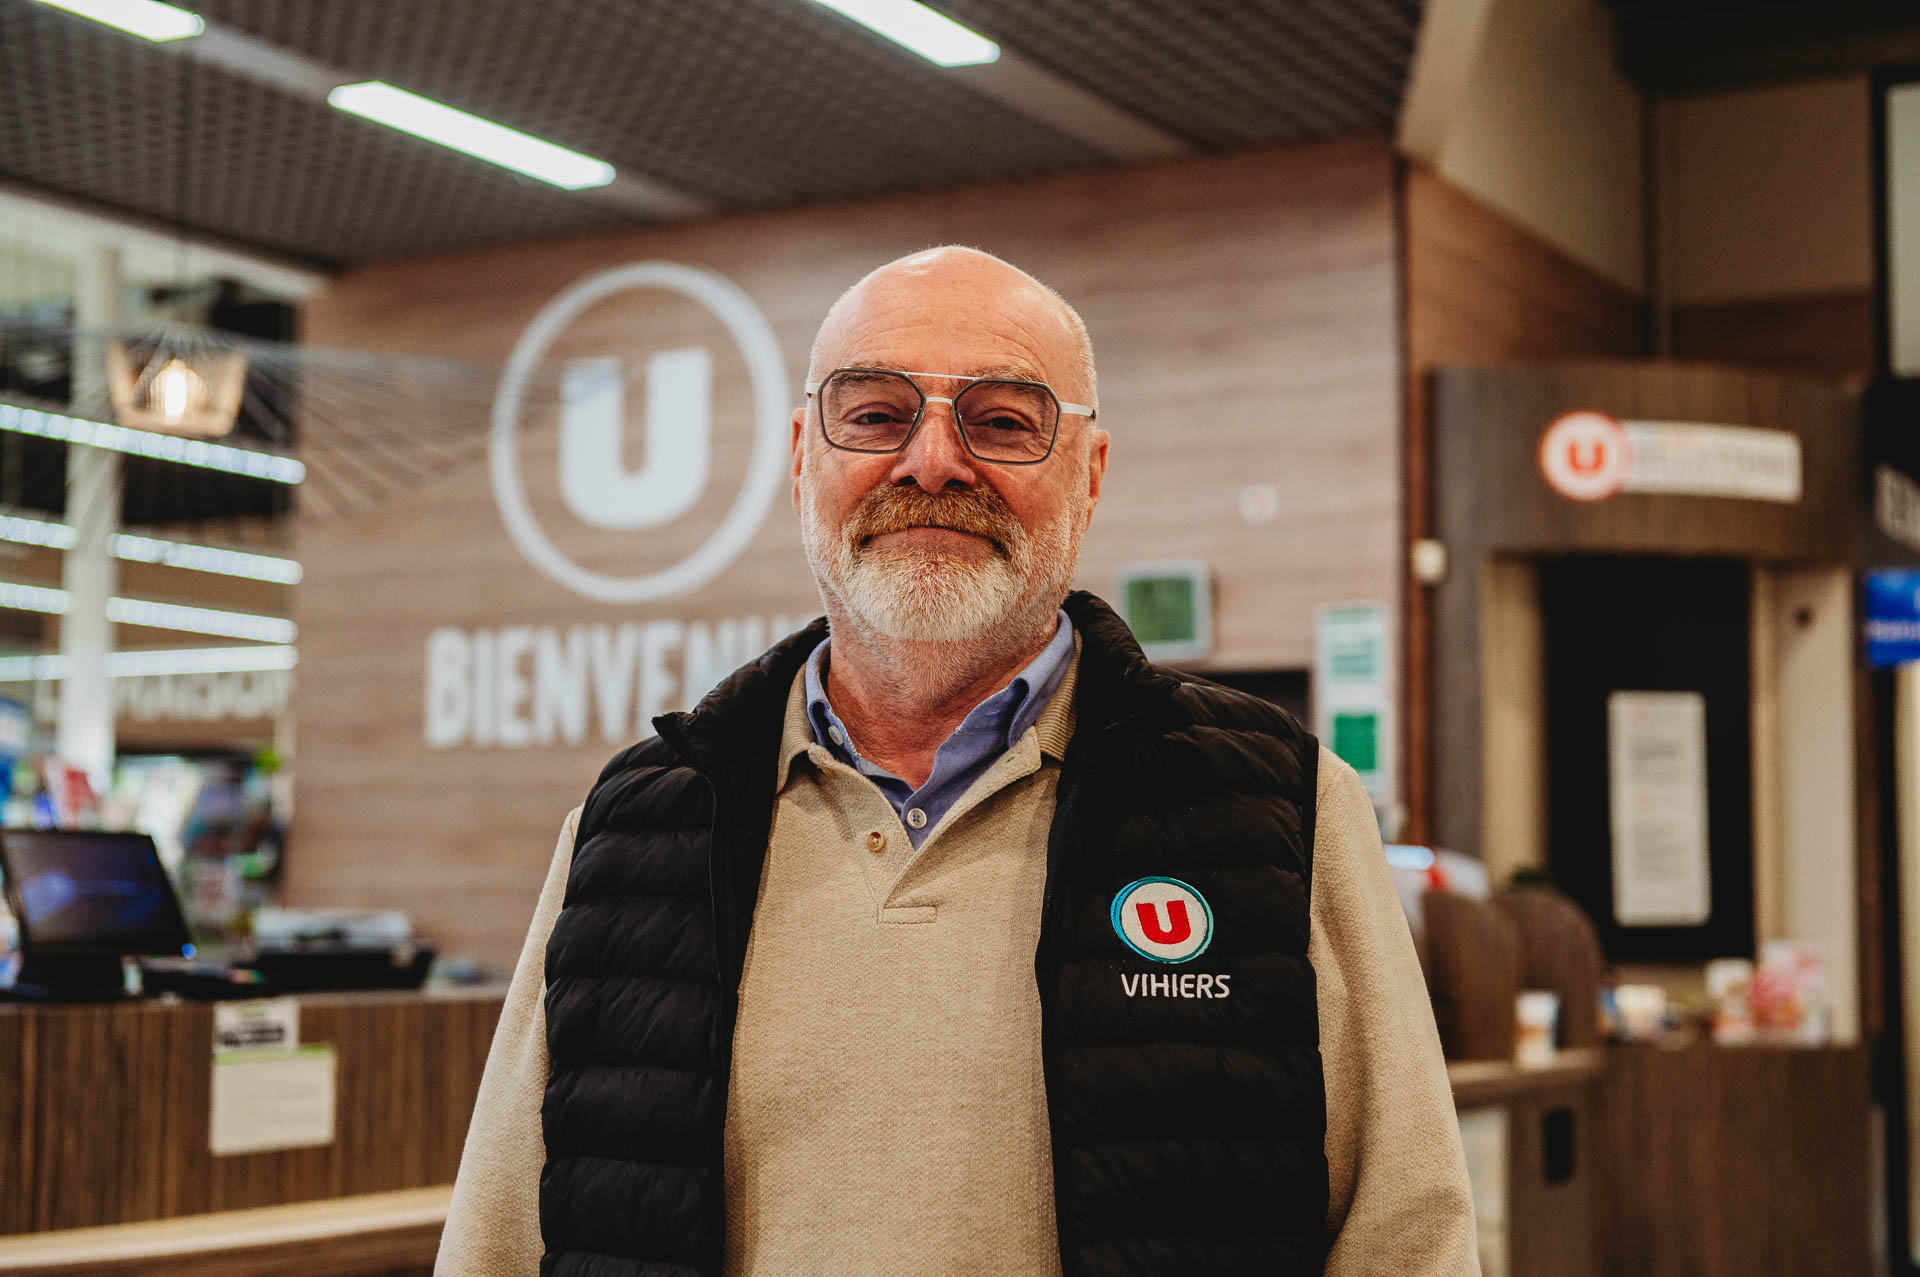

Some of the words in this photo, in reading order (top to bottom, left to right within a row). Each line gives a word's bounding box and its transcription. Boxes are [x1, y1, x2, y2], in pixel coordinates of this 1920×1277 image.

[560, 349, 713, 530] U
[1566, 440, 1605, 477] U
[425, 613, 826, 748] BIENVEN
[1136, 900, 1191, 945] U
[1121, 973, 1231, 999] VIHIERS
